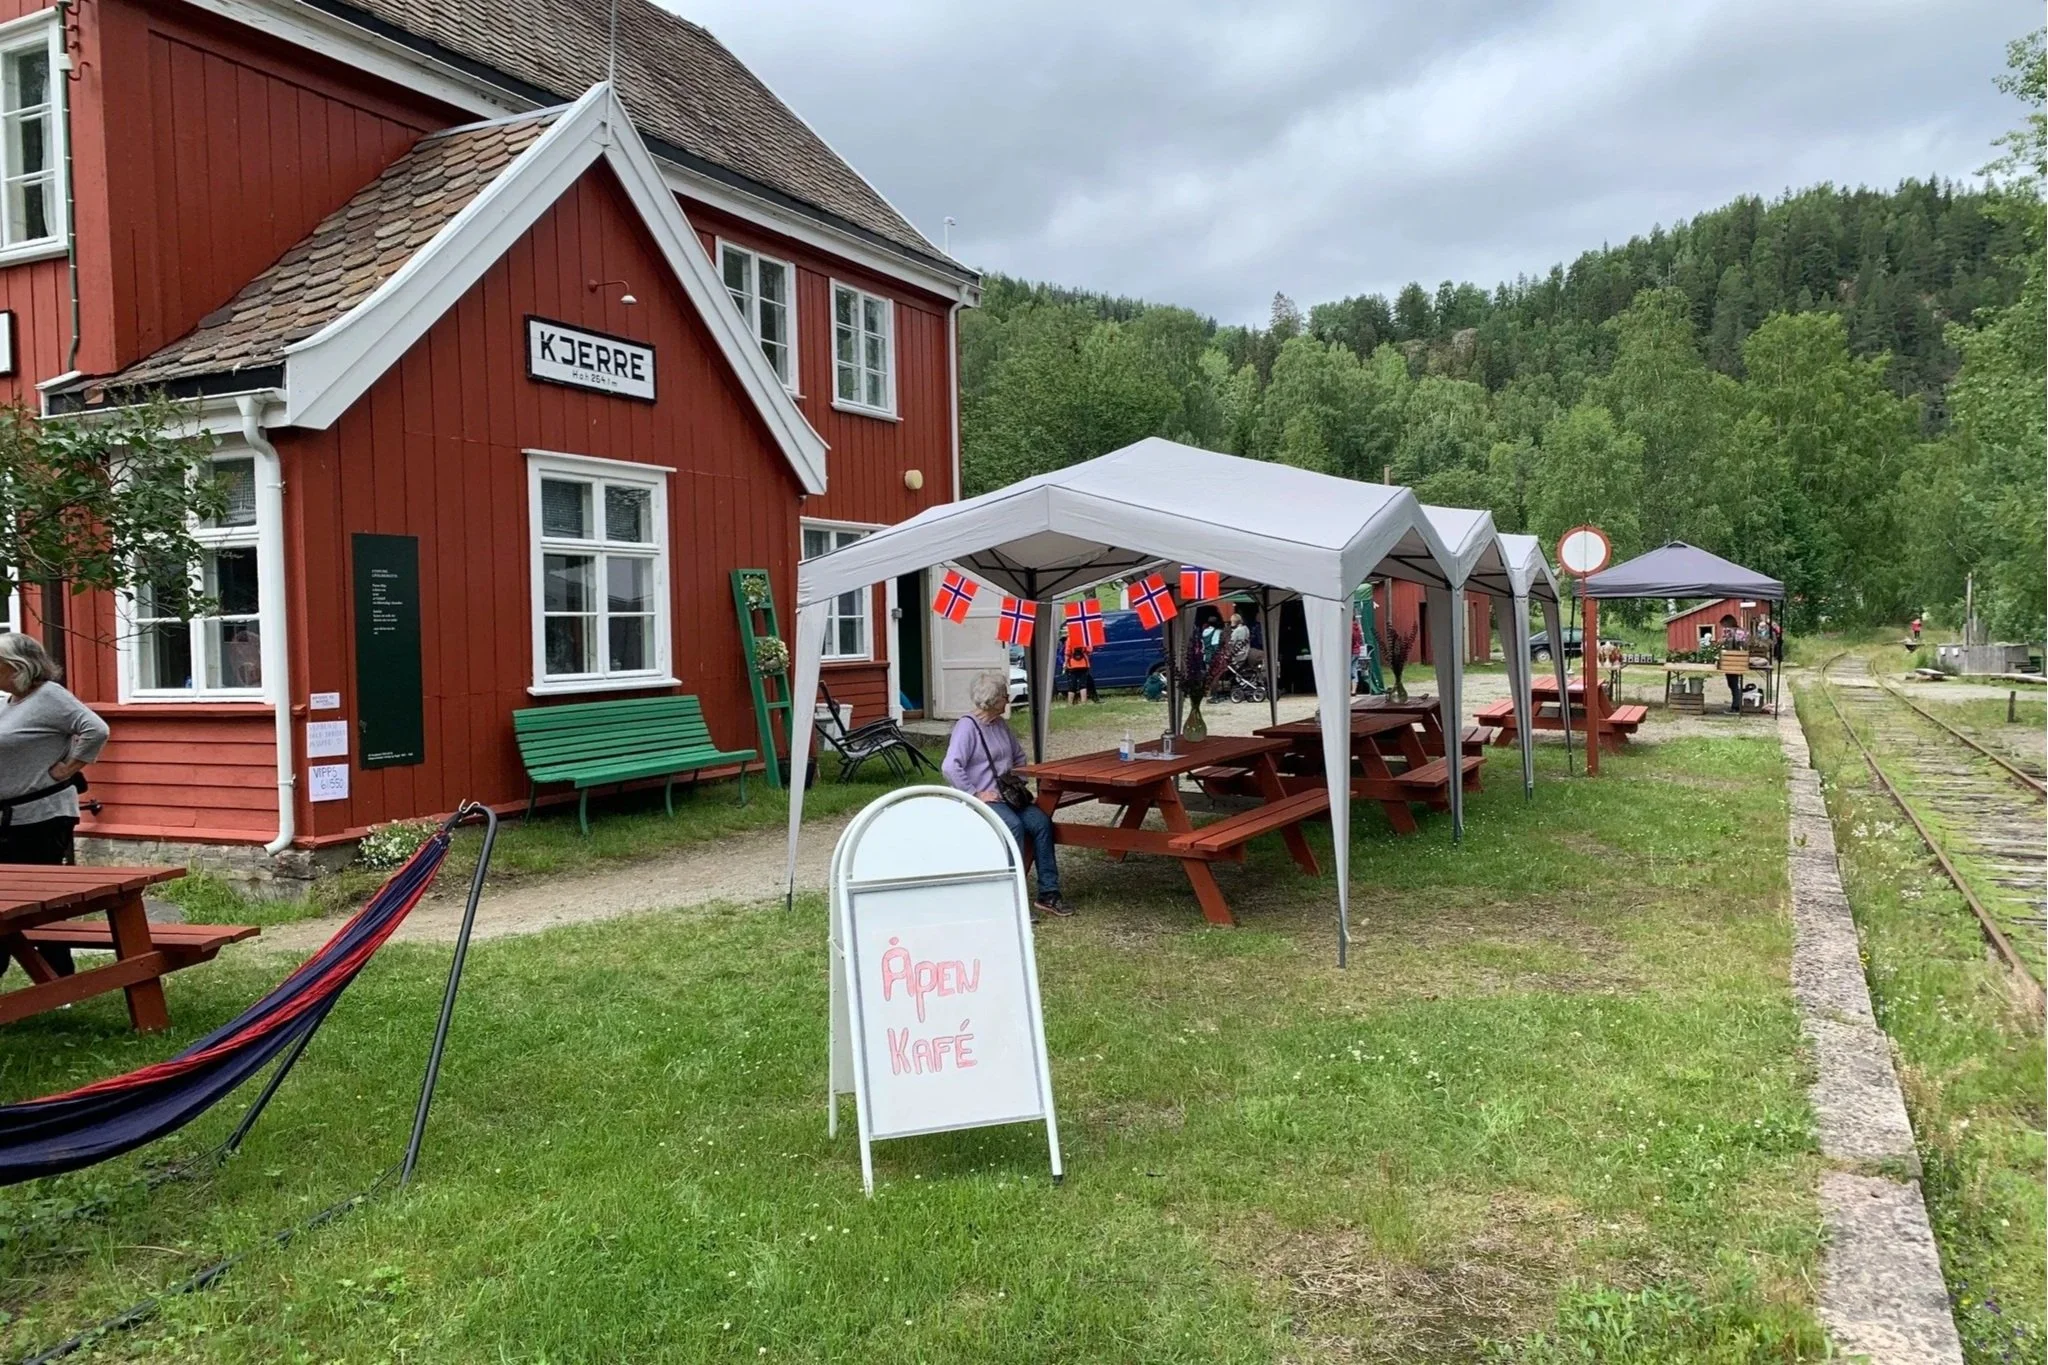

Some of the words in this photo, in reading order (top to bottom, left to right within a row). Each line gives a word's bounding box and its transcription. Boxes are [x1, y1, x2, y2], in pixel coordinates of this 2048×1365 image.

[540, 331, 645, 381] KJERRE
[312, 766, 338, 779] VIPPS
[886, 1018, 978, 1075] KAFÉ
